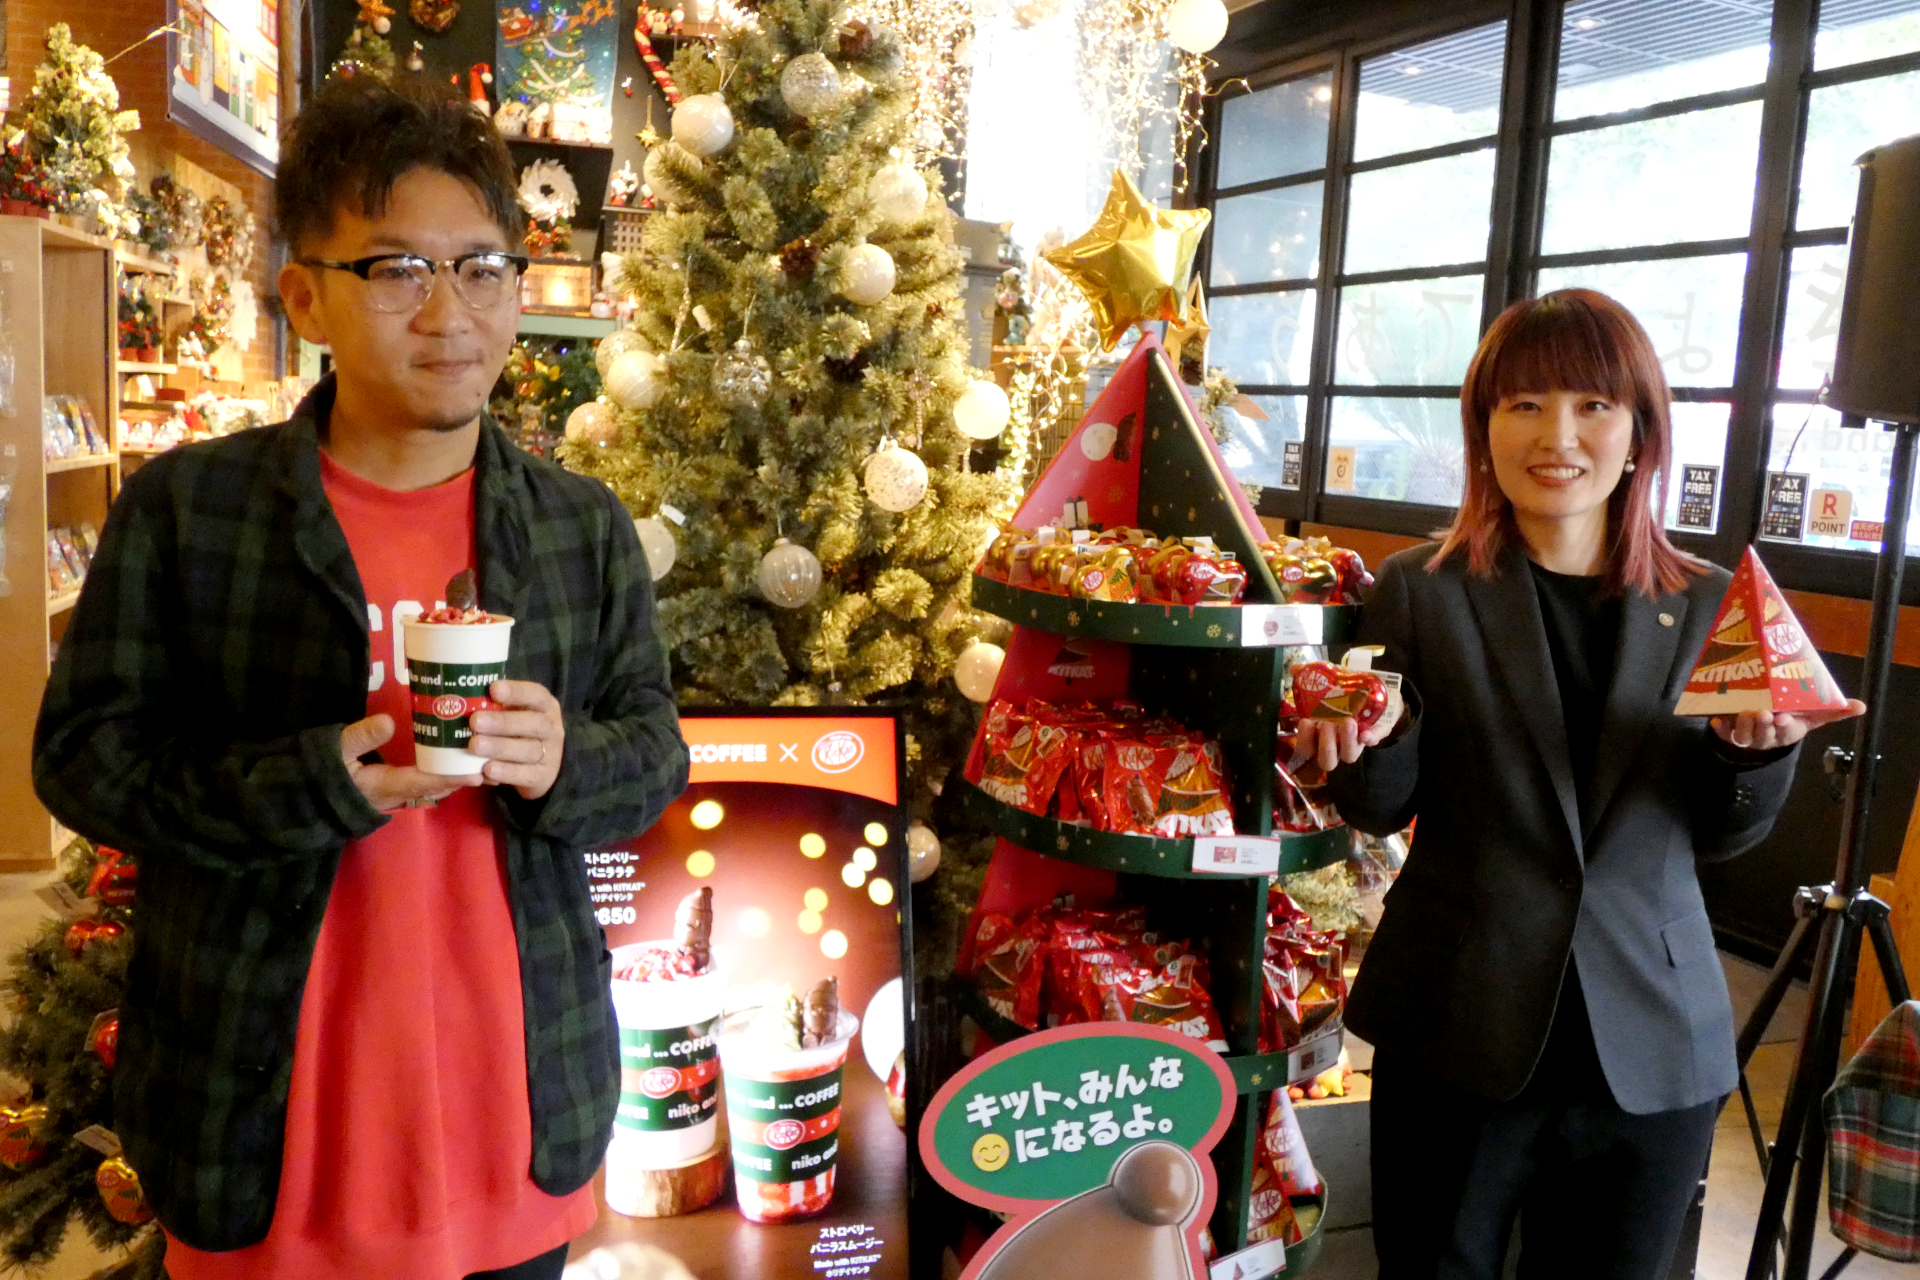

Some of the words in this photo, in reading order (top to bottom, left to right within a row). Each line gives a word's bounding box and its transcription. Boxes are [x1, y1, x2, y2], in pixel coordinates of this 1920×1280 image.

[1690, 469, 1711, 482] TAX
[1684, 482, 1712, 495] FREE
[1822, 493, 1838, 515] R
[1811, 521, 1846, 534] POINT
[420, 673, 441, 686] and
[413, 722, 438, 737] OFFEE
[689, 743, 767, 763] COFFEE
[583, 851, 640, 865] ストロベリー
[794, 1082, 840, 1108] COFFEE
[965, 1056, 1184, 1129] キット、みんな
[668, 1102, 700, 1119] niko
[1015, 1103, 1173, 1164] になるよ。
[791, 1154, 822, 1170] niko
[819, 1224, 874, 1239] ストロベリー
[810, 1237, 884, 1255] バニラスムージー
